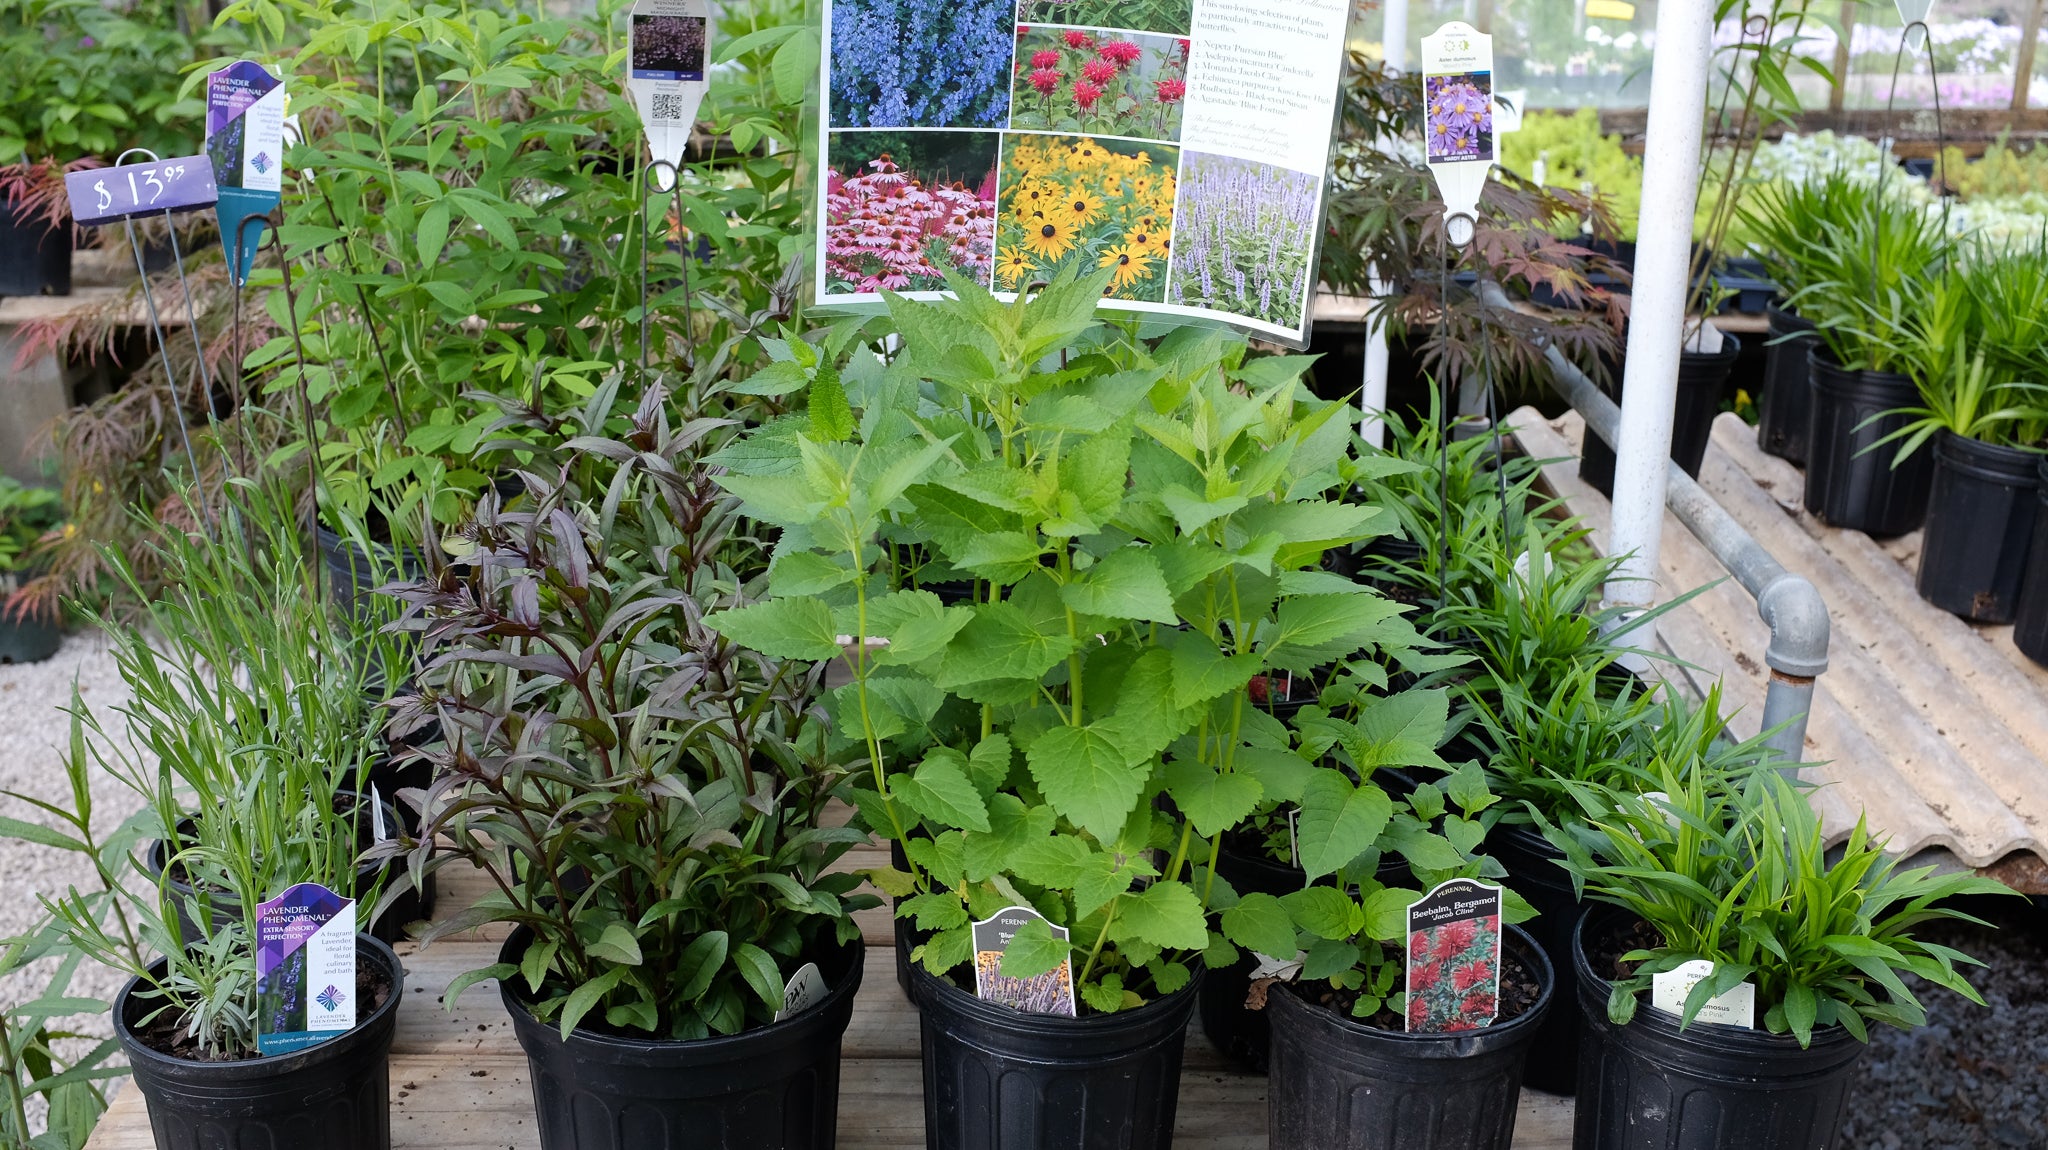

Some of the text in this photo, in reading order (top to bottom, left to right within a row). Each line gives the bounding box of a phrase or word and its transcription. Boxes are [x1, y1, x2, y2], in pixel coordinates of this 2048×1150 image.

[1219, 3, 1258, 16] sun-loving
[1259, 9, 1291, 20] selection
[1301, 17, 1324, 28] plants
[1208, 13, 1249, 25] particularly
[1252, 19, 1287, 31] attractive
[1297, 27, 1313, 37] bees
[1314, 31, 1328, 39] and
[1204, 39, 1232, 52] Nepeta
[1205, 51, 1238, 63] Asclepias
[1240, 58, 1273, 69] incarnata
[1202, 61, 1237, 73] Monarda
[214, 76, 250, 87] LAVENDER
[1200, 82, 1240, 97] Rudbeckia
[1246, 90, 1284, 106] Black-eyed
[1286, 98, 1309, 110] Susan
[1200, 94, 1238, 107] Agastache
[94, 179, 112, 215] $
[1437, 886, 1473, 898] PERENNIAL
[263, 905, 309, 915] LAVENDER
[1412, 896, 1496, 920] Beebalm, Bergamot
[1431, 906, 1477, 922] 'Jacob Cline'
[1001, 918, 1028, 926] PERENN
[263, 926, 284, 934] EXTRA
[327, 930, 353, 938] fragrant
[321, 937, 353, 945] Lavender,
[326, 960, 353, 968] culinary
[1702, 1004, 1730, 1012] umosus
